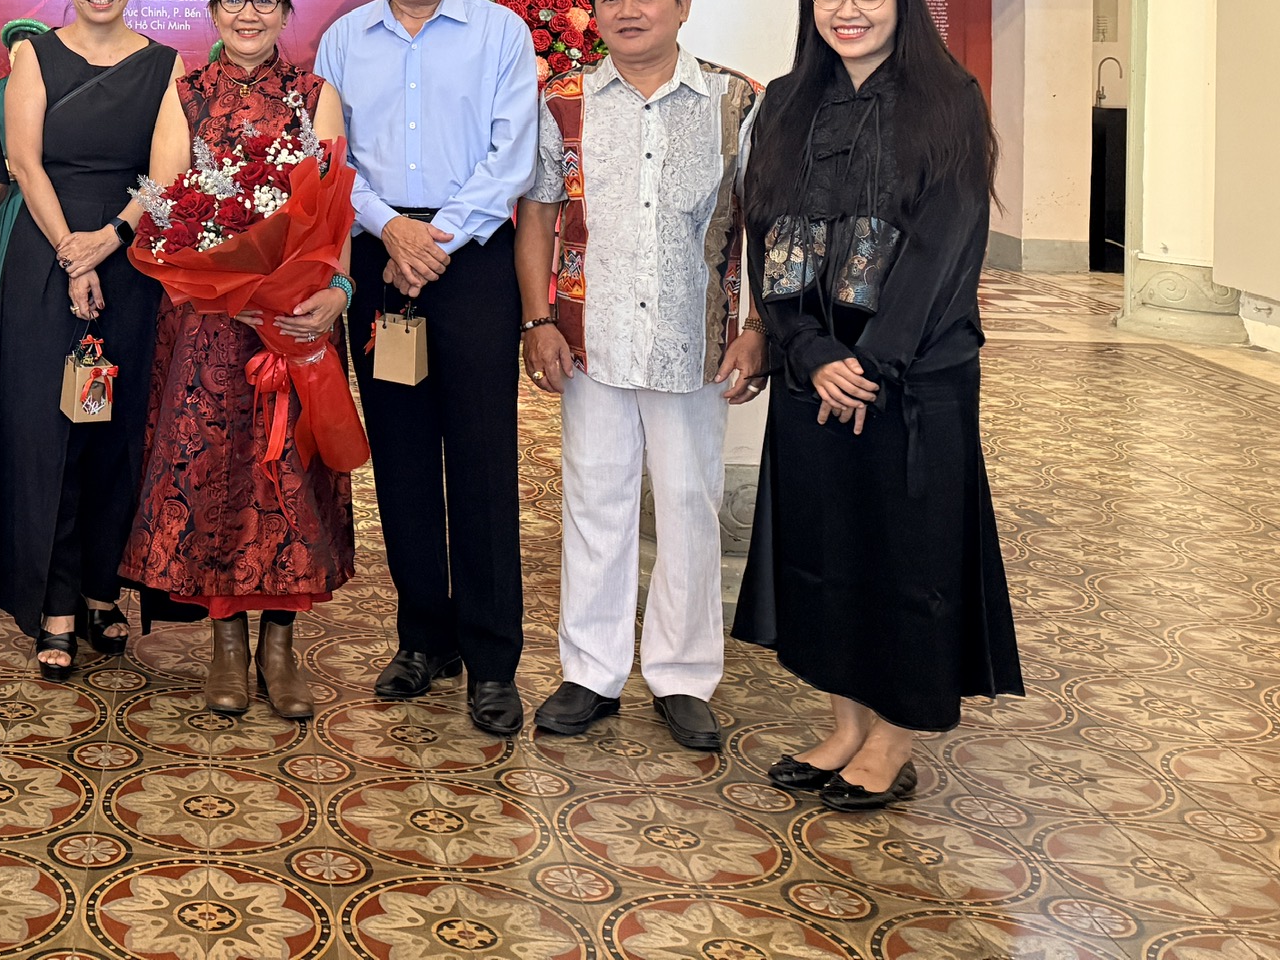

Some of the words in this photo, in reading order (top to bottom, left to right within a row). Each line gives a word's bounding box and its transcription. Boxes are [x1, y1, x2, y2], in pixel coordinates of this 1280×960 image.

[173, 7, 181, 18] P.
[184, 7, 201, 18] Bến
[167, 20, 191, 30] Minh
